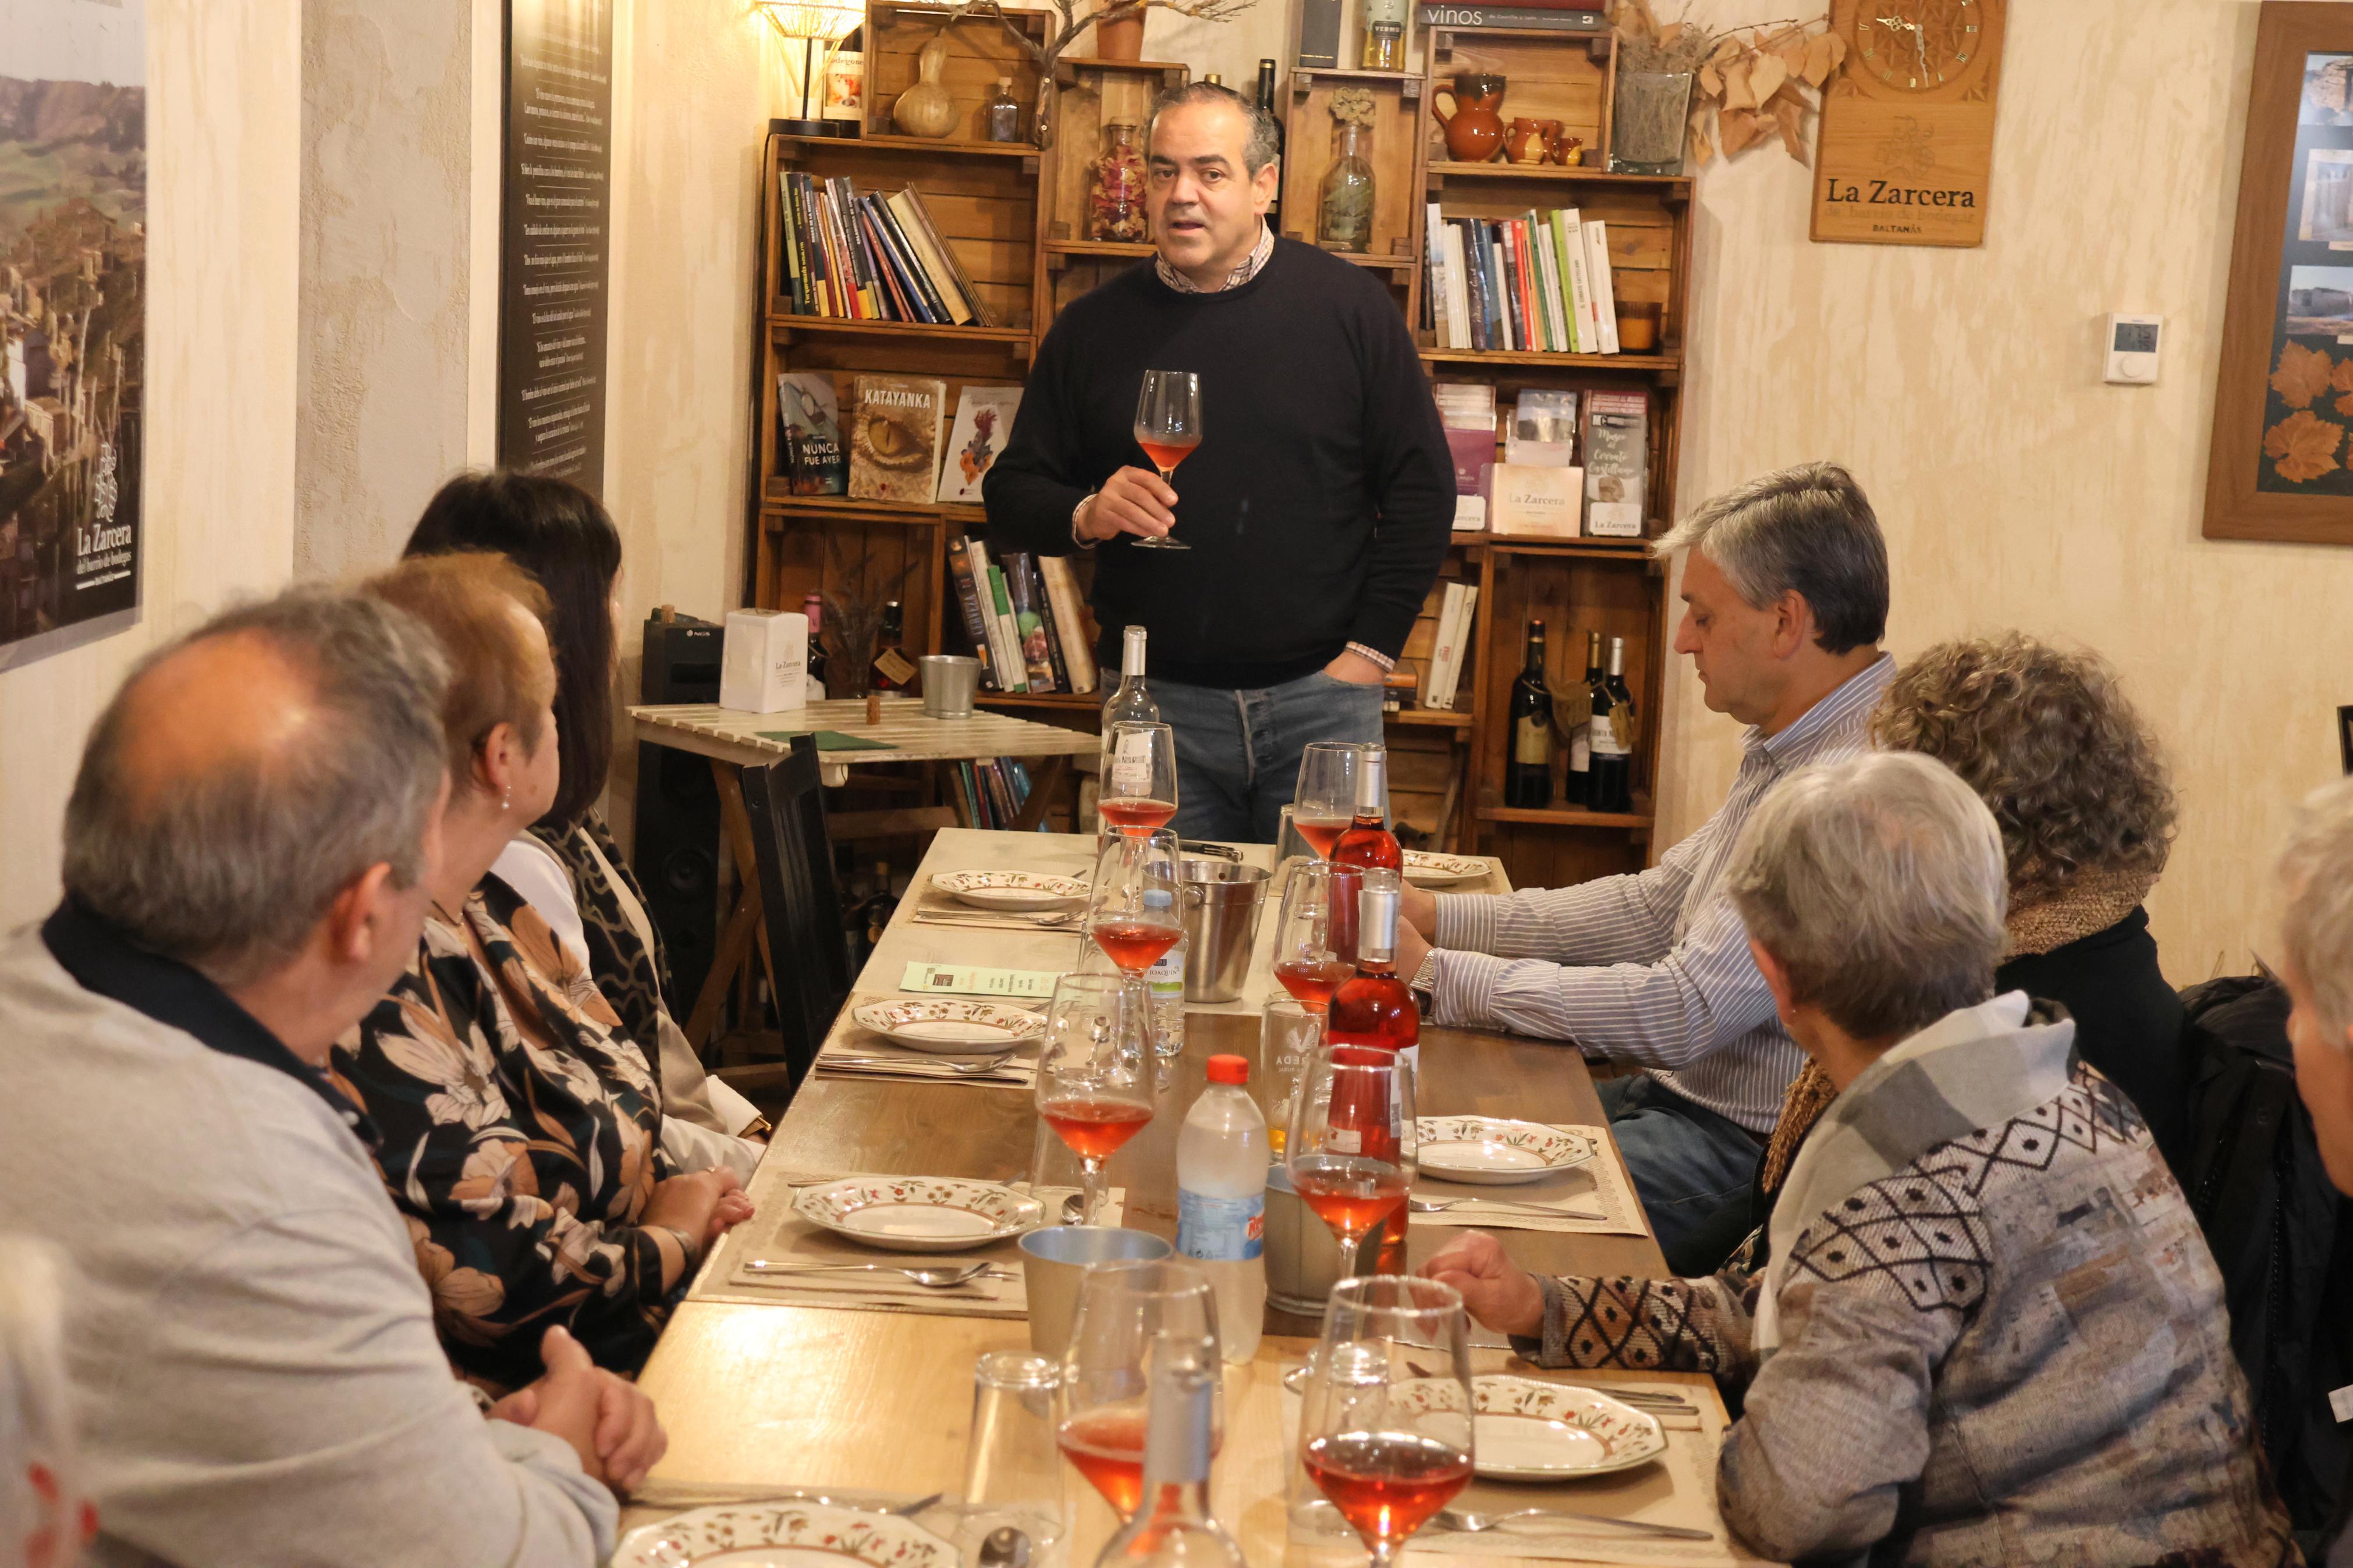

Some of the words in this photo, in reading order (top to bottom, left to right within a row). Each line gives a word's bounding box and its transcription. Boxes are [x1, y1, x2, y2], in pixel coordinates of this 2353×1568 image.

[1427, 5, 1483, 25] vinos
[826, 56, 864, 66] odegone
[1826, 179, 1860, 202] La
[1869, 180, 1975, 208] Zarcera
[1872, 223, 1922, 233] BALTANÁS
[801, 266, 811, 304] Torquemada
[864, 389, 931, 408] KATAYANKA
[803, 443, 840, 454] NUNCA
[804, 456, 820, 465] FUE
[822, 455, 841, 464] AYER
[1509, 493, 1521, 504] La
[1524, 495, 1565, 506] Zarcera
[1606, 521, 1637, 529] Zarcera
[77, 527, 91, 556] La
[93, 523, 132, 552] Zarcera
[964, 593, 984, 636] CERVEZA
[775, 662, 782, 670] La
[782, 660, 801, 669] Zarcera
